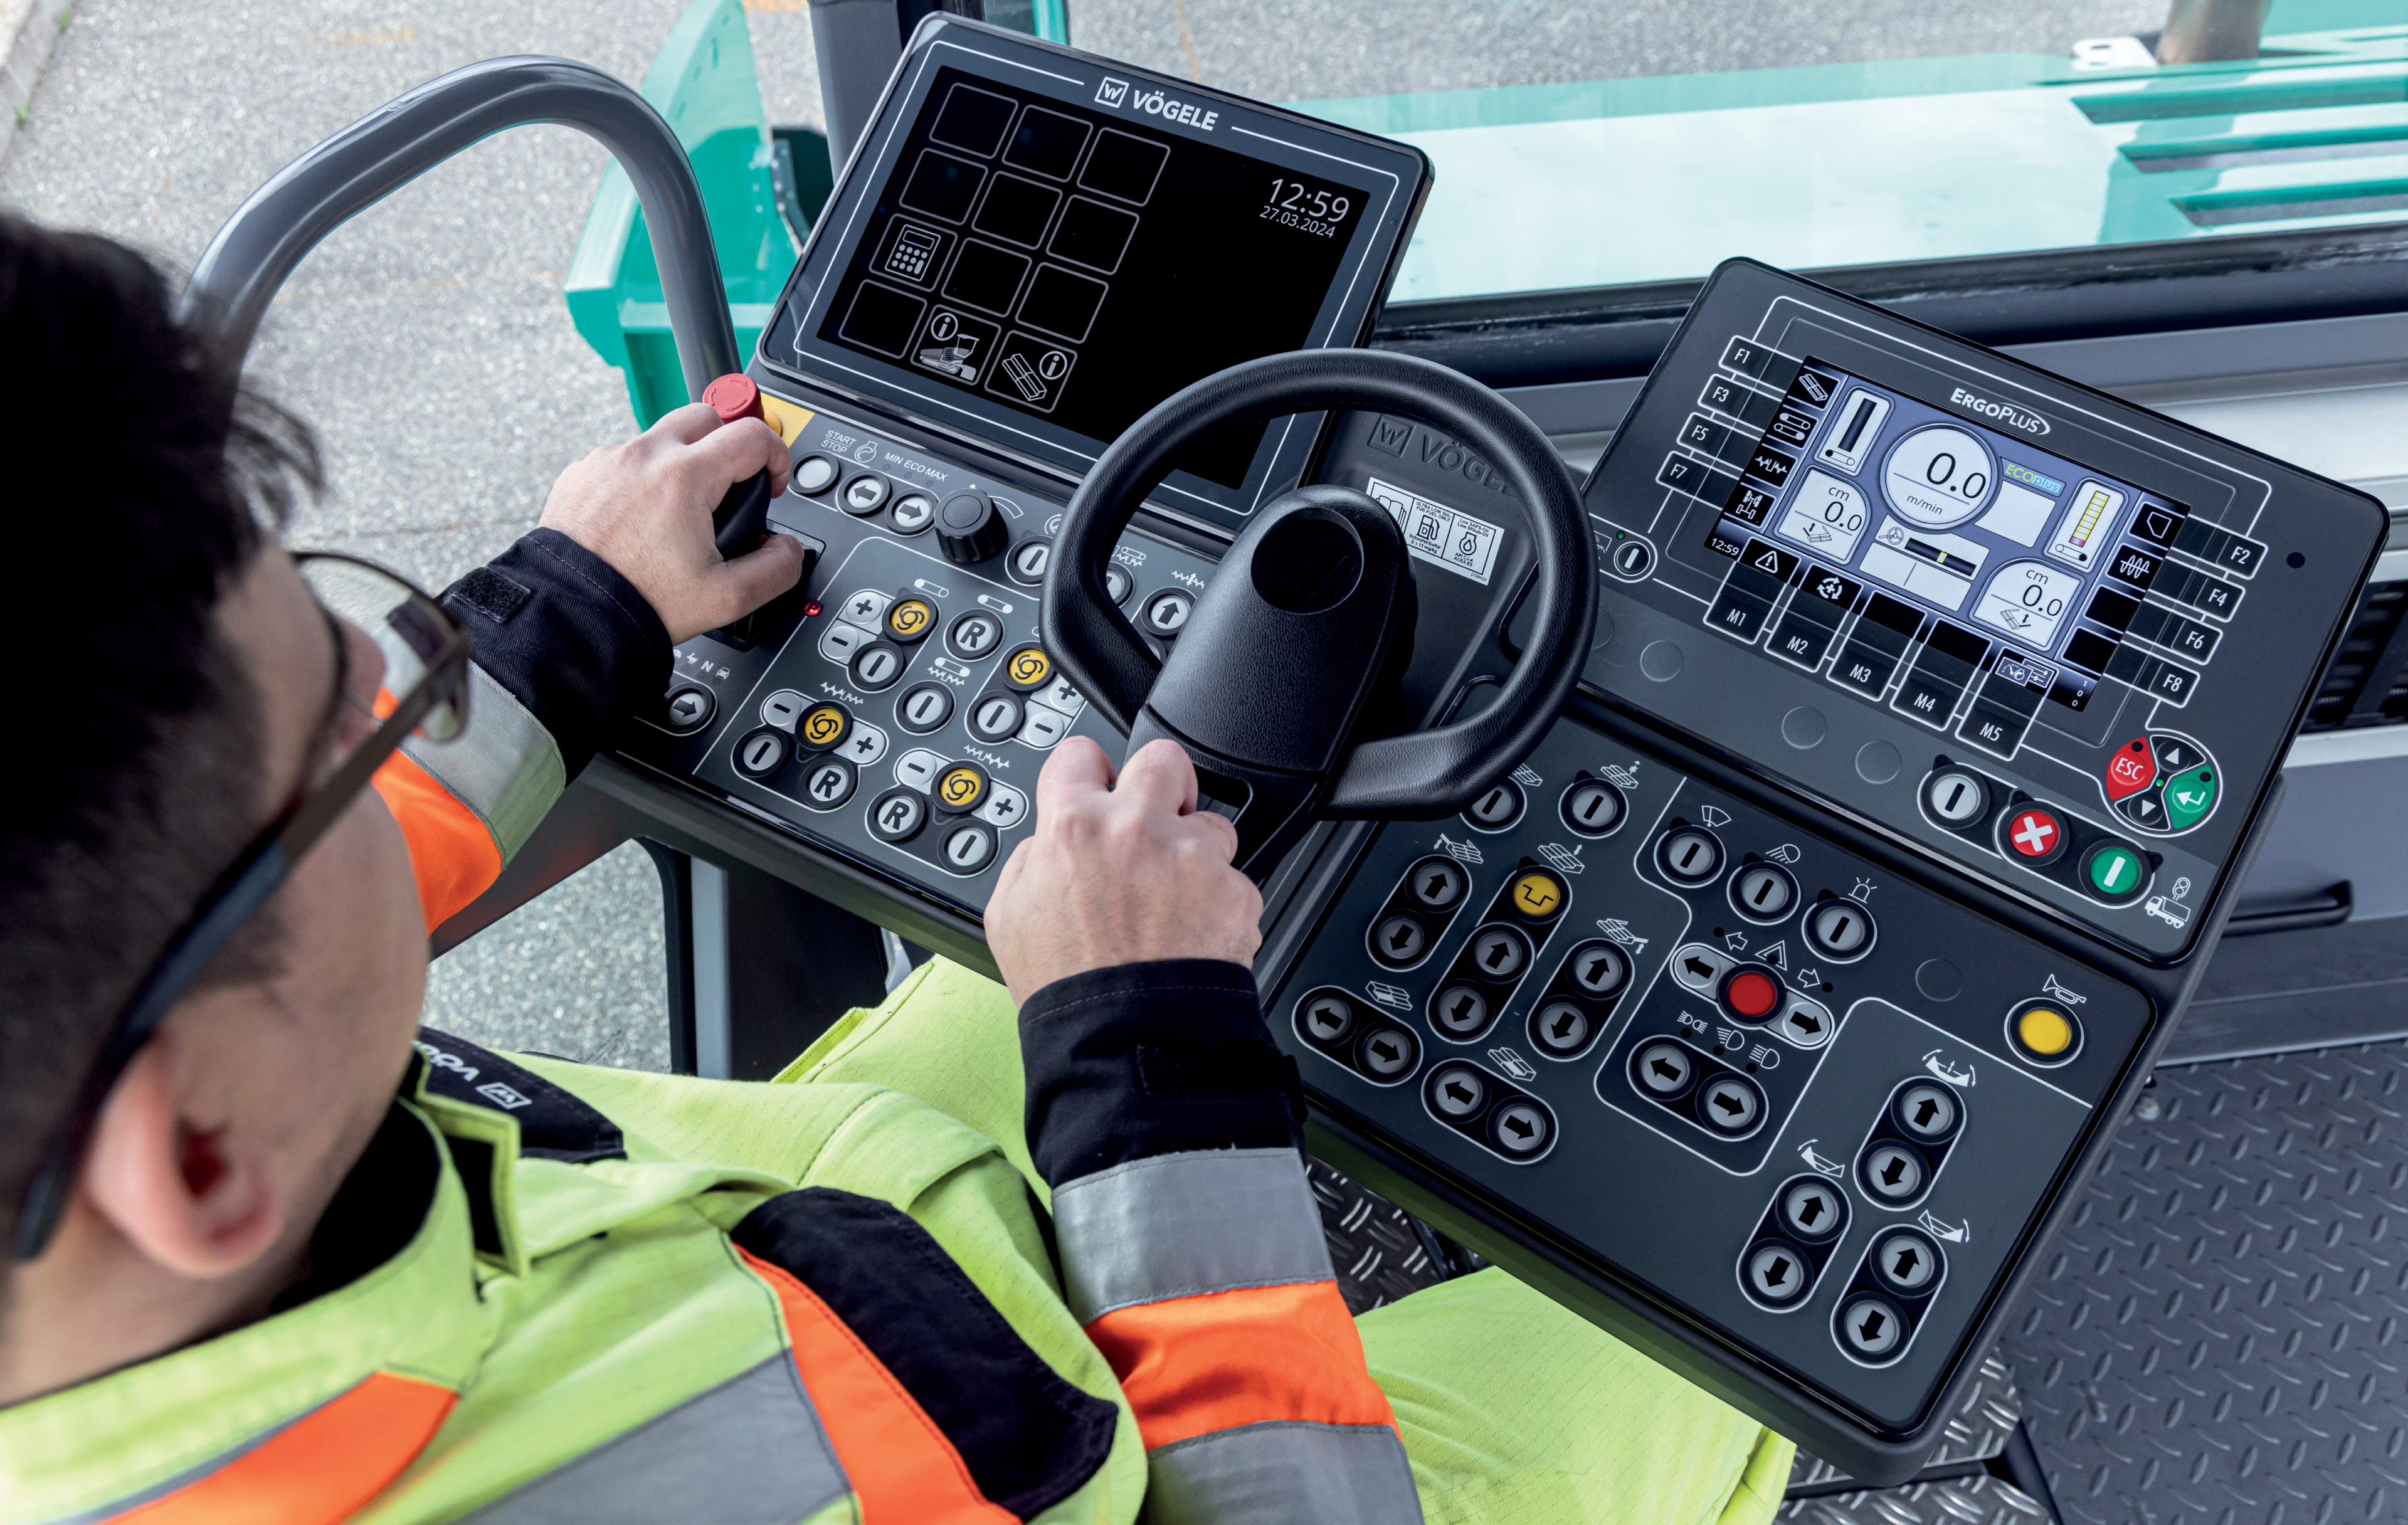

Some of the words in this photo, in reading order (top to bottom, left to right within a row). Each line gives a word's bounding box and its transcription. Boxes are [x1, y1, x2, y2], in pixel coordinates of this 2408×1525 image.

[1133, 90, 1219, 131] VÖGELE
[1270, 179, 1349, 222] 12:59
[1260, 206, 1336, 238] 27.03.2024
[1734, 348, 1750, 364] F1
[1713, 386, 1729, 402] F3
[825, 430, 857, 446] START
[1691, 425, 1709, 441] F5
[821, 440, 847, 453] STOP
[884, 452, 904, 465] MIN
[904, 460, 926, 473] ECO
[925, 468, 948, 482] MAX
[1670, 463, 1688, 479] F7
[1926, 452, 1987, 499] 0.0
[2005, 463, 2059, 493] ECOplus
[1828, 486, 1851, 502] cm
[1416, 501, 1430, 510] ULTRA
[1906, 494, 1943, 515] m/min
[1824, 501, 1862, 531] 0.0
[1712, 538, 1739, 556] 12:59
[2231, 546, 2250, 564] F2
[1454, 556, 1466, 564] ACEA
[2026, 570, 2049, 584] cm
[2022, 584, 2062, 616] 0.0
[2208, 588, 2228, 606] F4
[805, 602, 819, 613] P
[1726, 608, 1746, 626] M1
[959, 621, 986, 649] R
[2185, 631, 2205, 649] F6
[1787, 636, 1809, 654] M2
[700, 660, 714, 672] N
[1849, 663, 1871, 683] M3
[2163, 673, 2182, 692] F8
[1913, 692, 1936, 712] M4
[1980, 722, 2003, 741] M5
[2115, 757, 2143, 779] ESC
[813, 769, 841, 799] R
[882, 800, 910, 831] R
